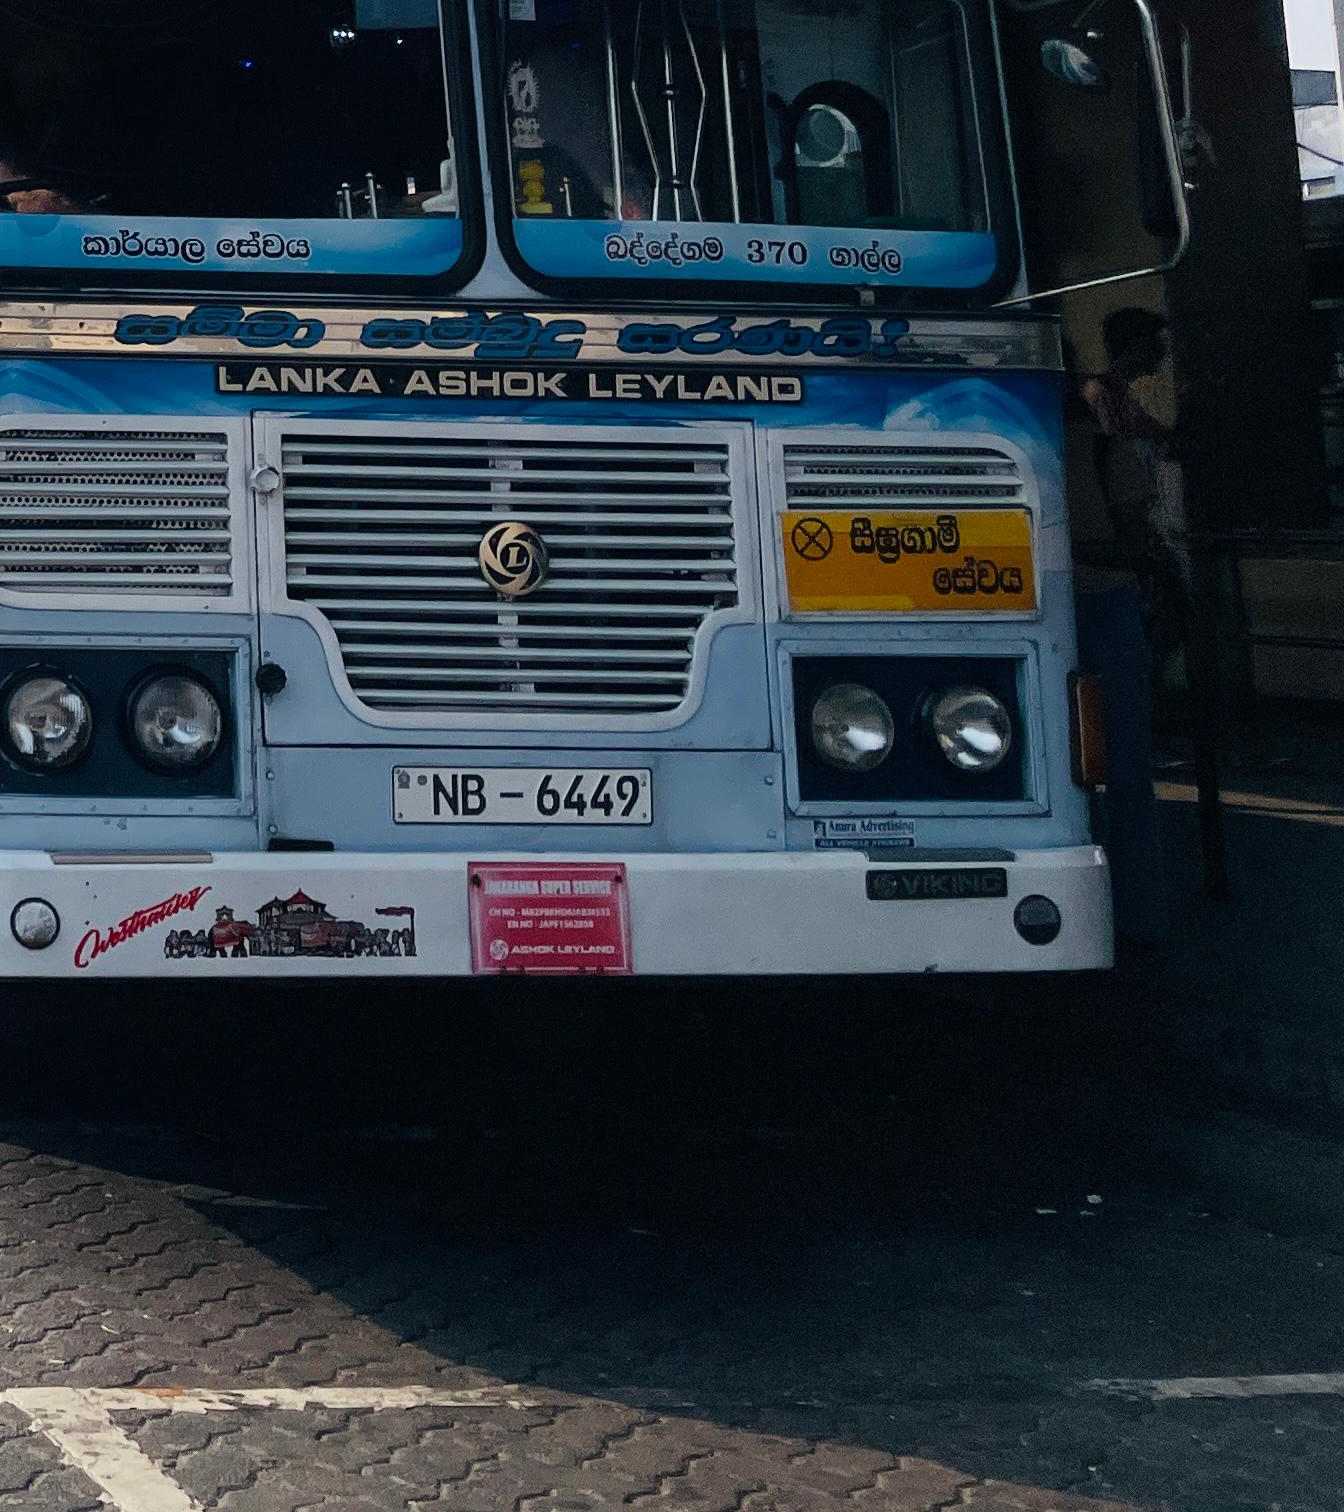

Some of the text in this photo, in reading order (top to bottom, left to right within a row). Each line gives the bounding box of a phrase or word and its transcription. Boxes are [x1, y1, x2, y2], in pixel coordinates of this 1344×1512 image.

[216, 231, 312, 258] සේවය
[605, 231, 902, 274] බද්දේගම 370 ගාල්ල
[219, 366, 802, 402] LANKA ASHOK LEYLAND
[933, 556, 1023, 595] සේවය
[512, 945, 616, 954] ASHOK LEYLAND
